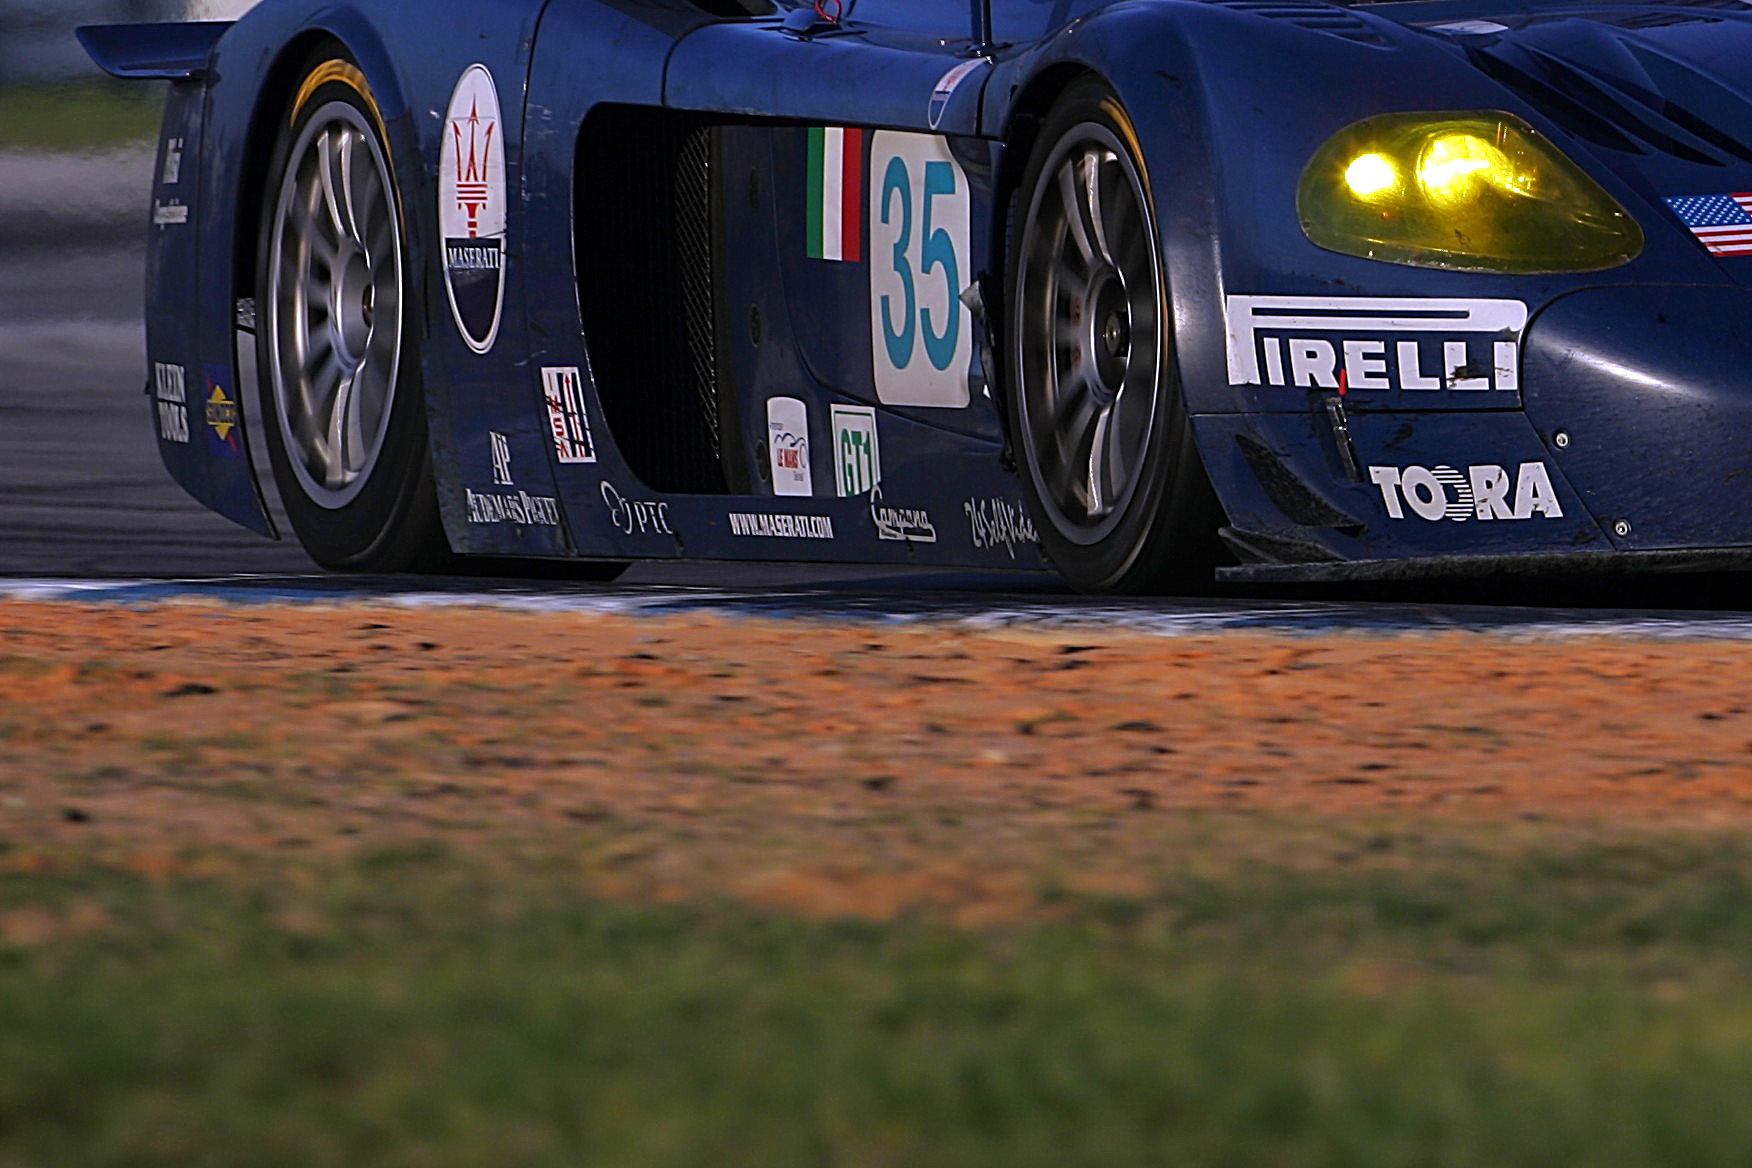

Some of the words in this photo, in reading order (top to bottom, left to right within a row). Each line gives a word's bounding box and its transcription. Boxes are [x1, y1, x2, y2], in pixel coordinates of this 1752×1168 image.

[447, 247, 500, 269] MASERATI
[881, 156, 960, 371] 35
[1225, 295, 1528, 391] PIRELLI
[841, 428, 873, 497] GT1
[728, 512, 835, 539] WWW.MASERATI.COM
